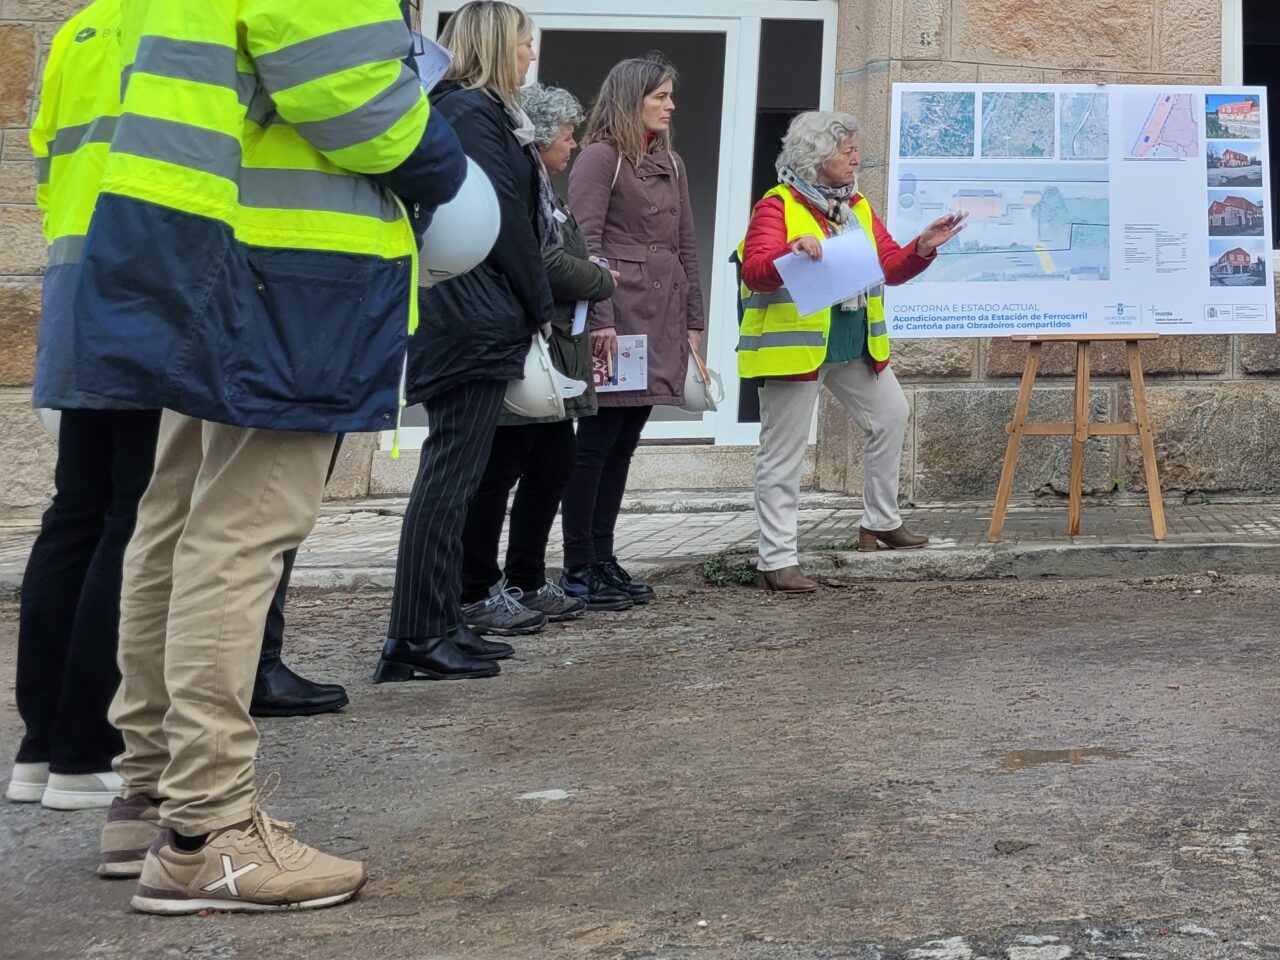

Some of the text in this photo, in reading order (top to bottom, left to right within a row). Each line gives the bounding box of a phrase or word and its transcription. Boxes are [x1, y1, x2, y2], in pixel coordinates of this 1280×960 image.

[893, 303, 1040, 313] CONTORNA E ESTADO ACTUAL
[892, 311, 1088, 323] Acondicionamento da Estación de Ferrocarril
[892, 320, 1072, 331] de Cantoña para Obradoiros compartidos
